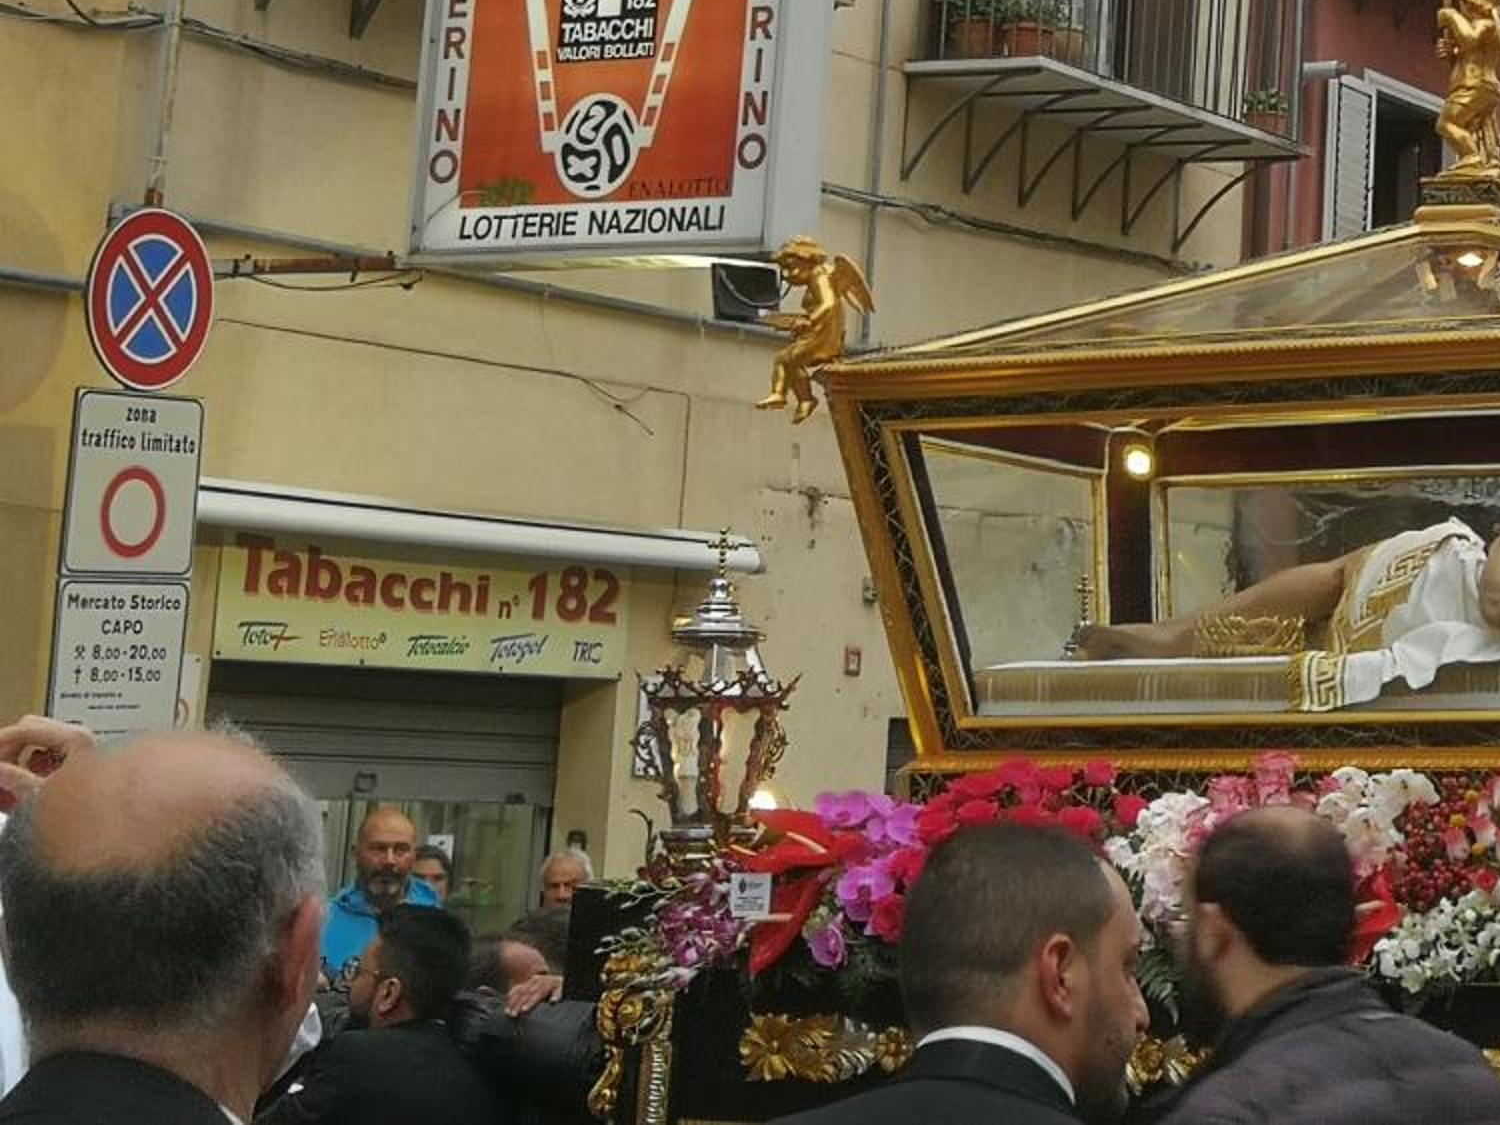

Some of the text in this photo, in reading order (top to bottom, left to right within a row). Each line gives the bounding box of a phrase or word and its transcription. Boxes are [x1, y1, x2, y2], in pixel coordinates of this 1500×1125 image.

[562, 18, 655, 43] TABACCHI
[557, 42, 655, 60] VALORI BOLLATI
[458, 205, 726, 240] LOTTERIE NAZIONALI
[126, 407, 157, 423] zona
[81, 428, 196, 454] traffico limitato
[235, 532, 491, 617] Tabacchi
[527, 565, 622, 626] 182
[67, 593, 181, 611] Mercato Storico
[101, 618, 144, 635] CAPO
